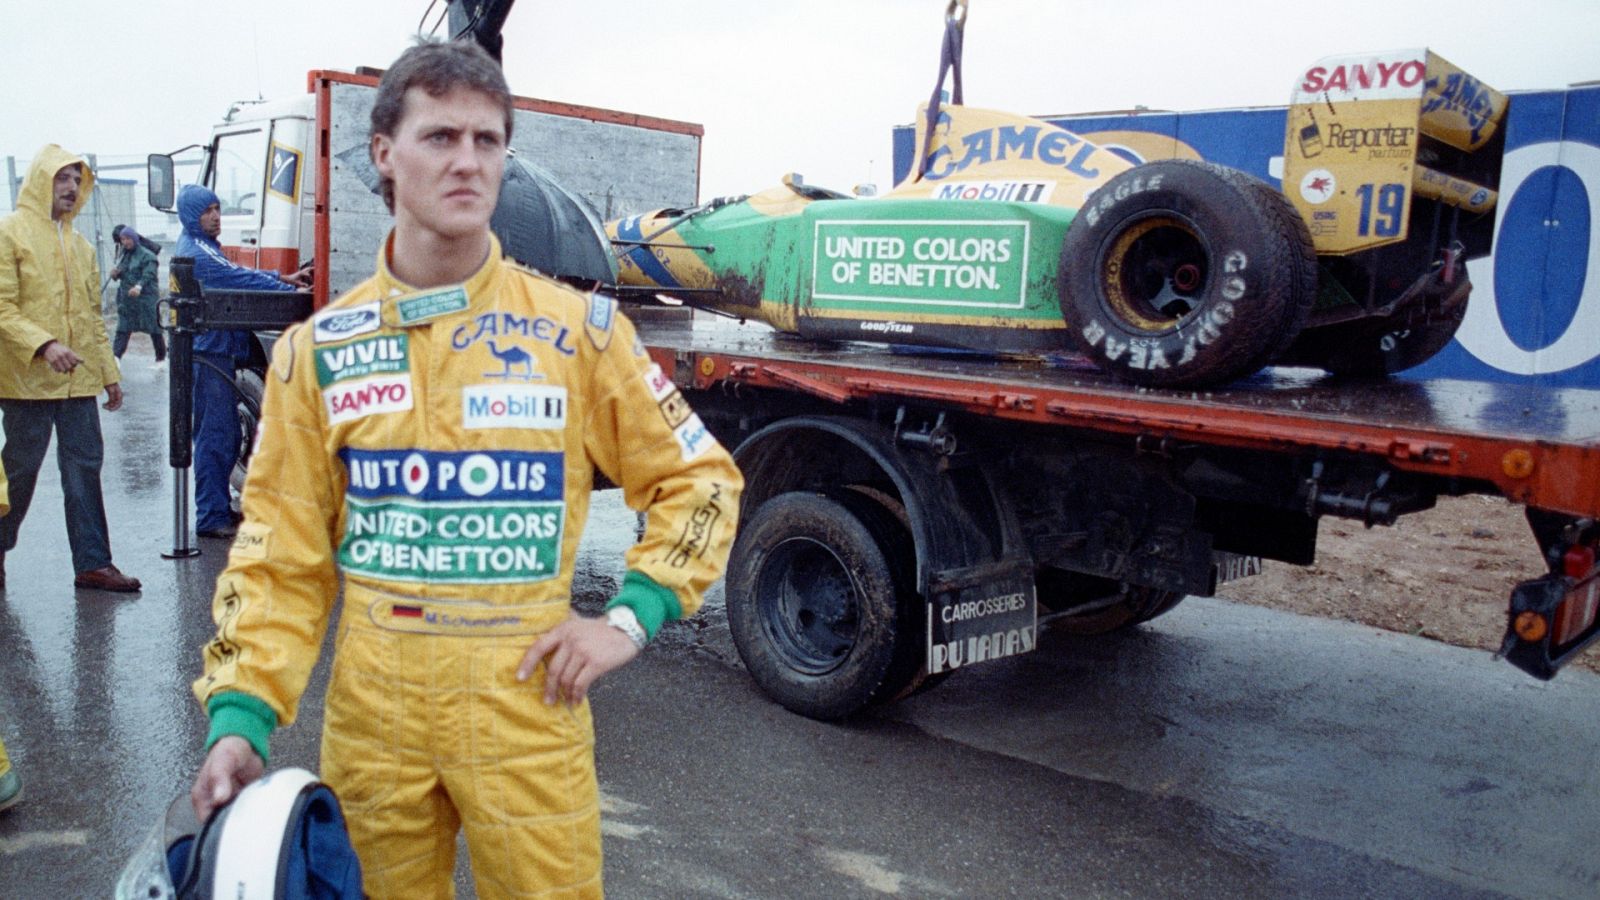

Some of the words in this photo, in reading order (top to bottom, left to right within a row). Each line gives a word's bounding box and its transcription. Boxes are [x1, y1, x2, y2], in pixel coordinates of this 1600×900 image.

[1302, 60, 1425, 93] SANYO
[924, 125, 1100, 181] CAMEL
[1325, 122, 1414, 153] Reporter
[938, 183, 1017, 201] Mobil
[1354, 183, 1406, 237] 19
[825, 236, 905, 260] UNITED
[913, 237, 1011, 263] COLORS
[832, 262, 860, 284] OF
[868, 263, 1001, 291] BENETTON.
[328, 311, 370, 333] Ford
[452, 311, 576, 356] CAMEL
[323, 338, 405, 373] VIVIL
[332, 383, 406, 415] SANYO
[469, 396, 537, 417] Mobil
[544, 397, 562, 418] 1
[437, 512, 558, 540] COLORS
[351, 539, 380, 565] OF
[379, 540, 545, 573] BENETTON.
[941, 593, 1026, 624] CARROSSERIES
[932, 626, 1035, 674] PUJADAS
